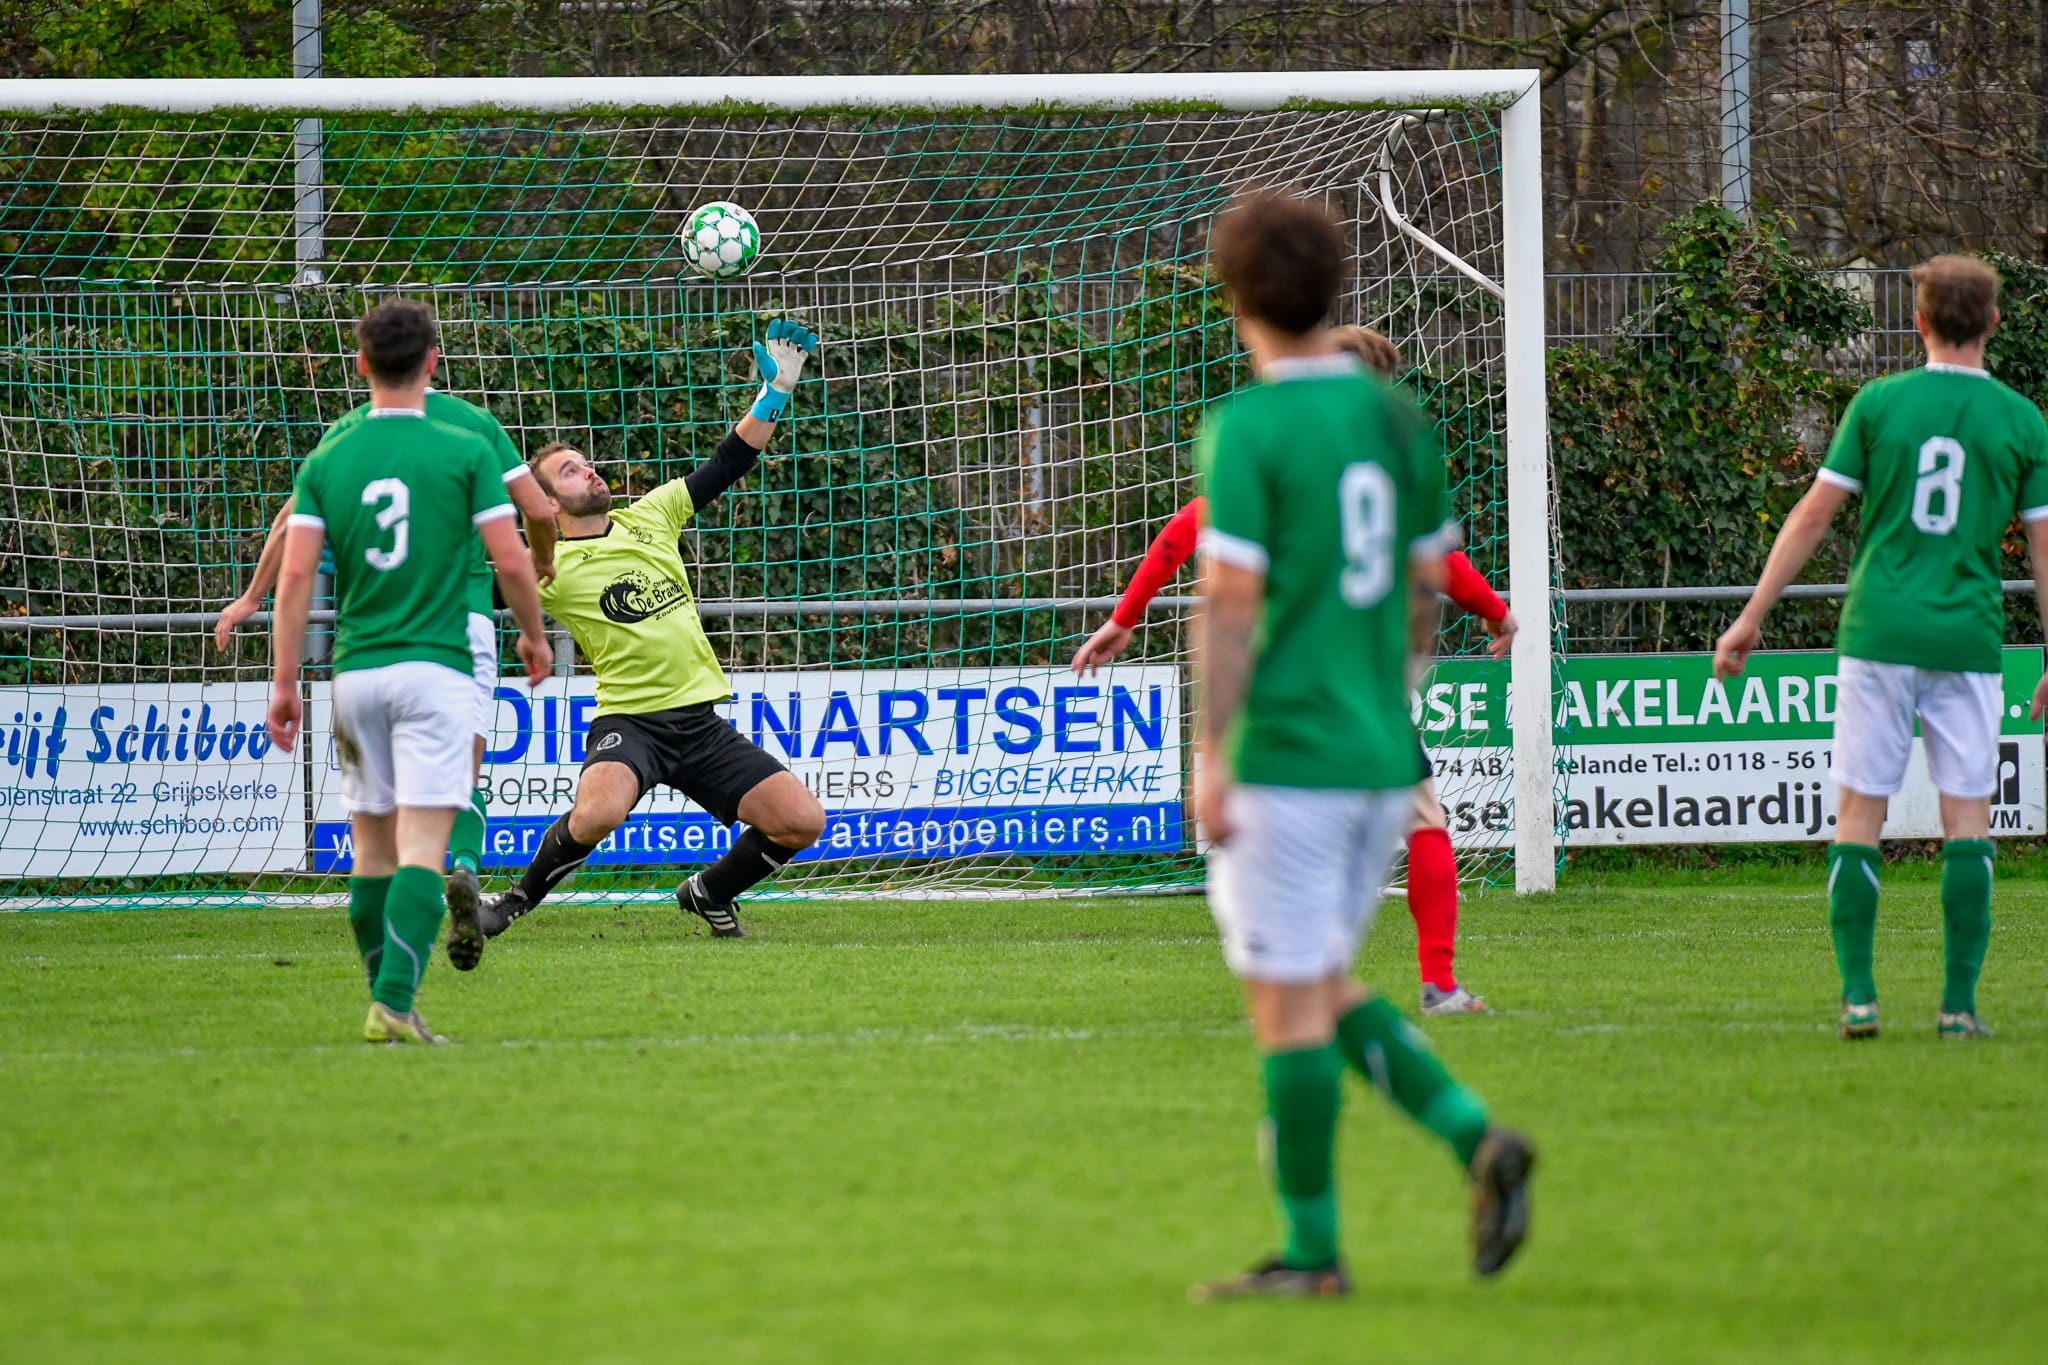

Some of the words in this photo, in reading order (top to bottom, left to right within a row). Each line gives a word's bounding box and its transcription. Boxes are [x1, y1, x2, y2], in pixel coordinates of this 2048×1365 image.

[1911, 435, 1966, 536] 8
[361, 477, 410, 571] 3
[1338, 461, 1397, 609] 9
[0, 706, 67, 779] ijf
[86, 703, 273, 763] Schiboo
[1471, 758, 1502, 777] AB
[1652, 752, 1700, 772] Tel.:
[1707, 752, 1765, 771] 0118
[1787, 751, 1815, 769] 56
[110, 782, 137, 803] 22
[153, 780, 277, 806] Grijpskerke
[934, 765, 1163, 796] BIGGEKERKE
[79, 813, 279, 836] www.schiboo.com
